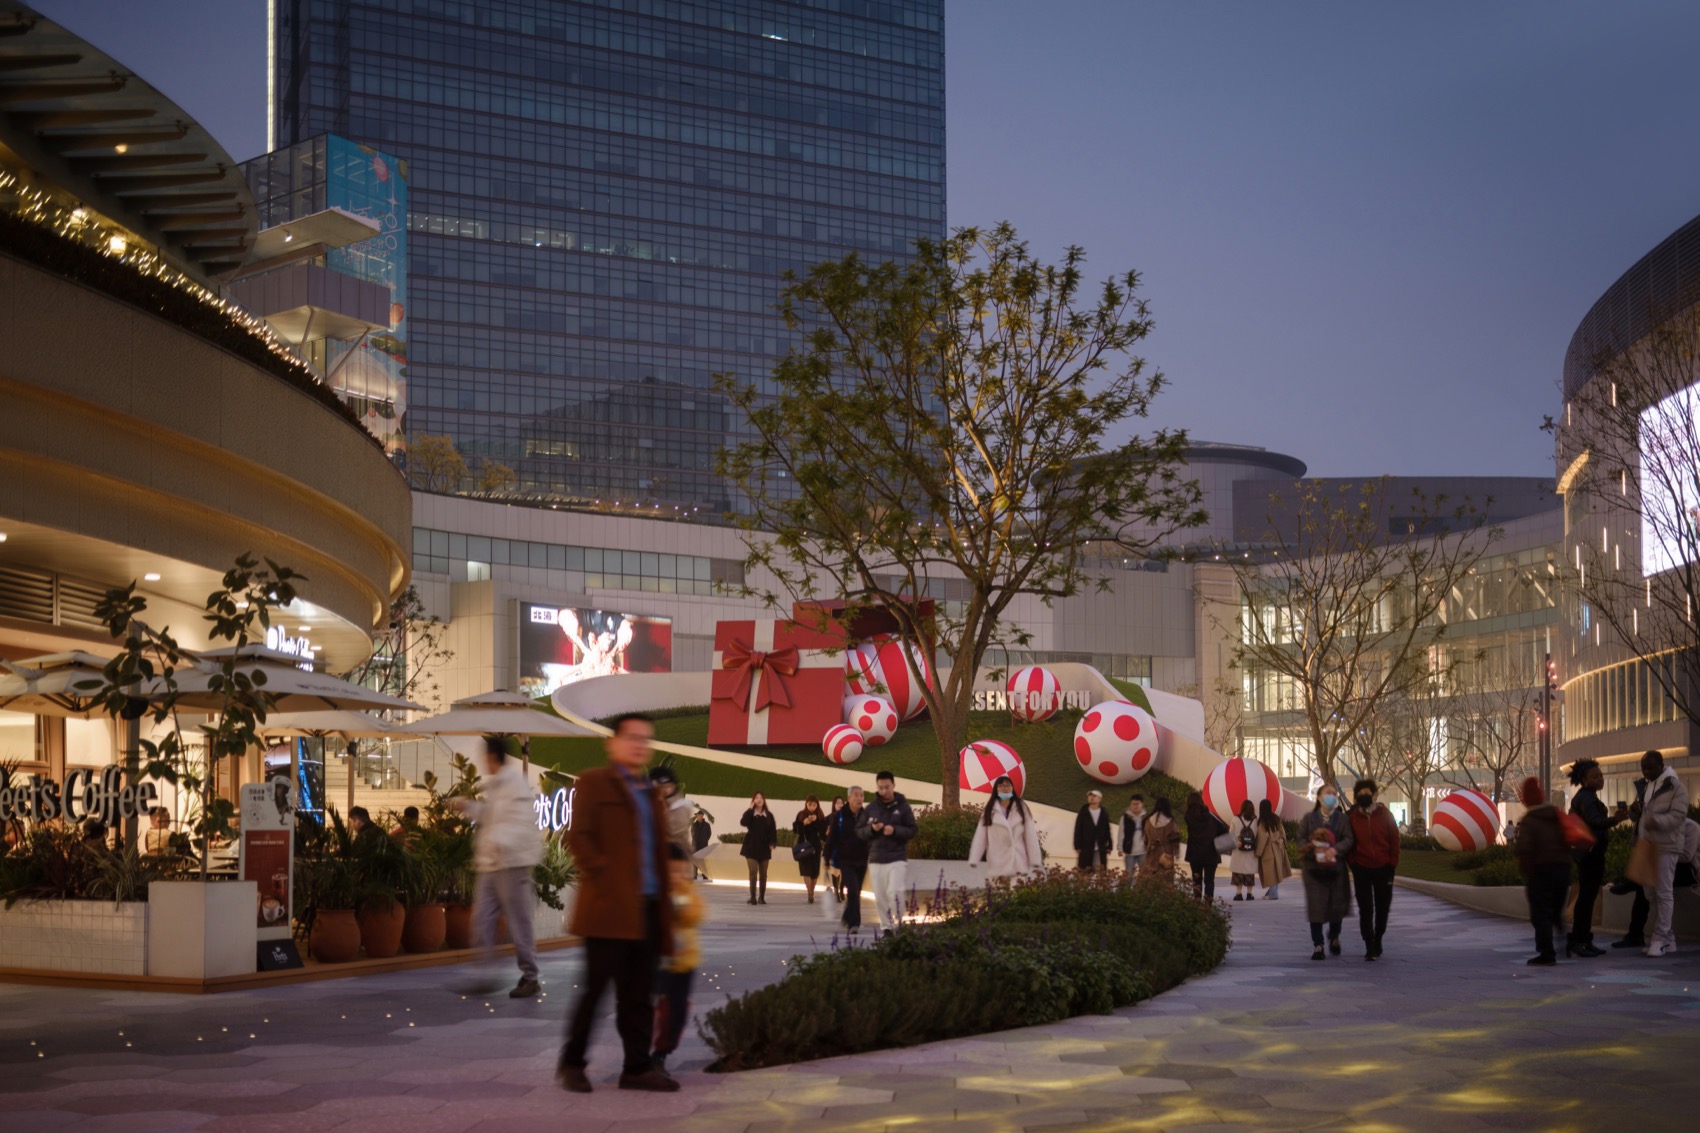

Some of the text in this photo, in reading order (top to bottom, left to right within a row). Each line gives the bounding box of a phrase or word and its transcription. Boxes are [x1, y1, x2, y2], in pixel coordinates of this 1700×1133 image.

[1020, 690, 1053, 711] FOR
[1056, 690, 1090, 711] YOU
[0, 764, 157, 827] eet's Coffee
[552, 787, 577, 831] Cof
